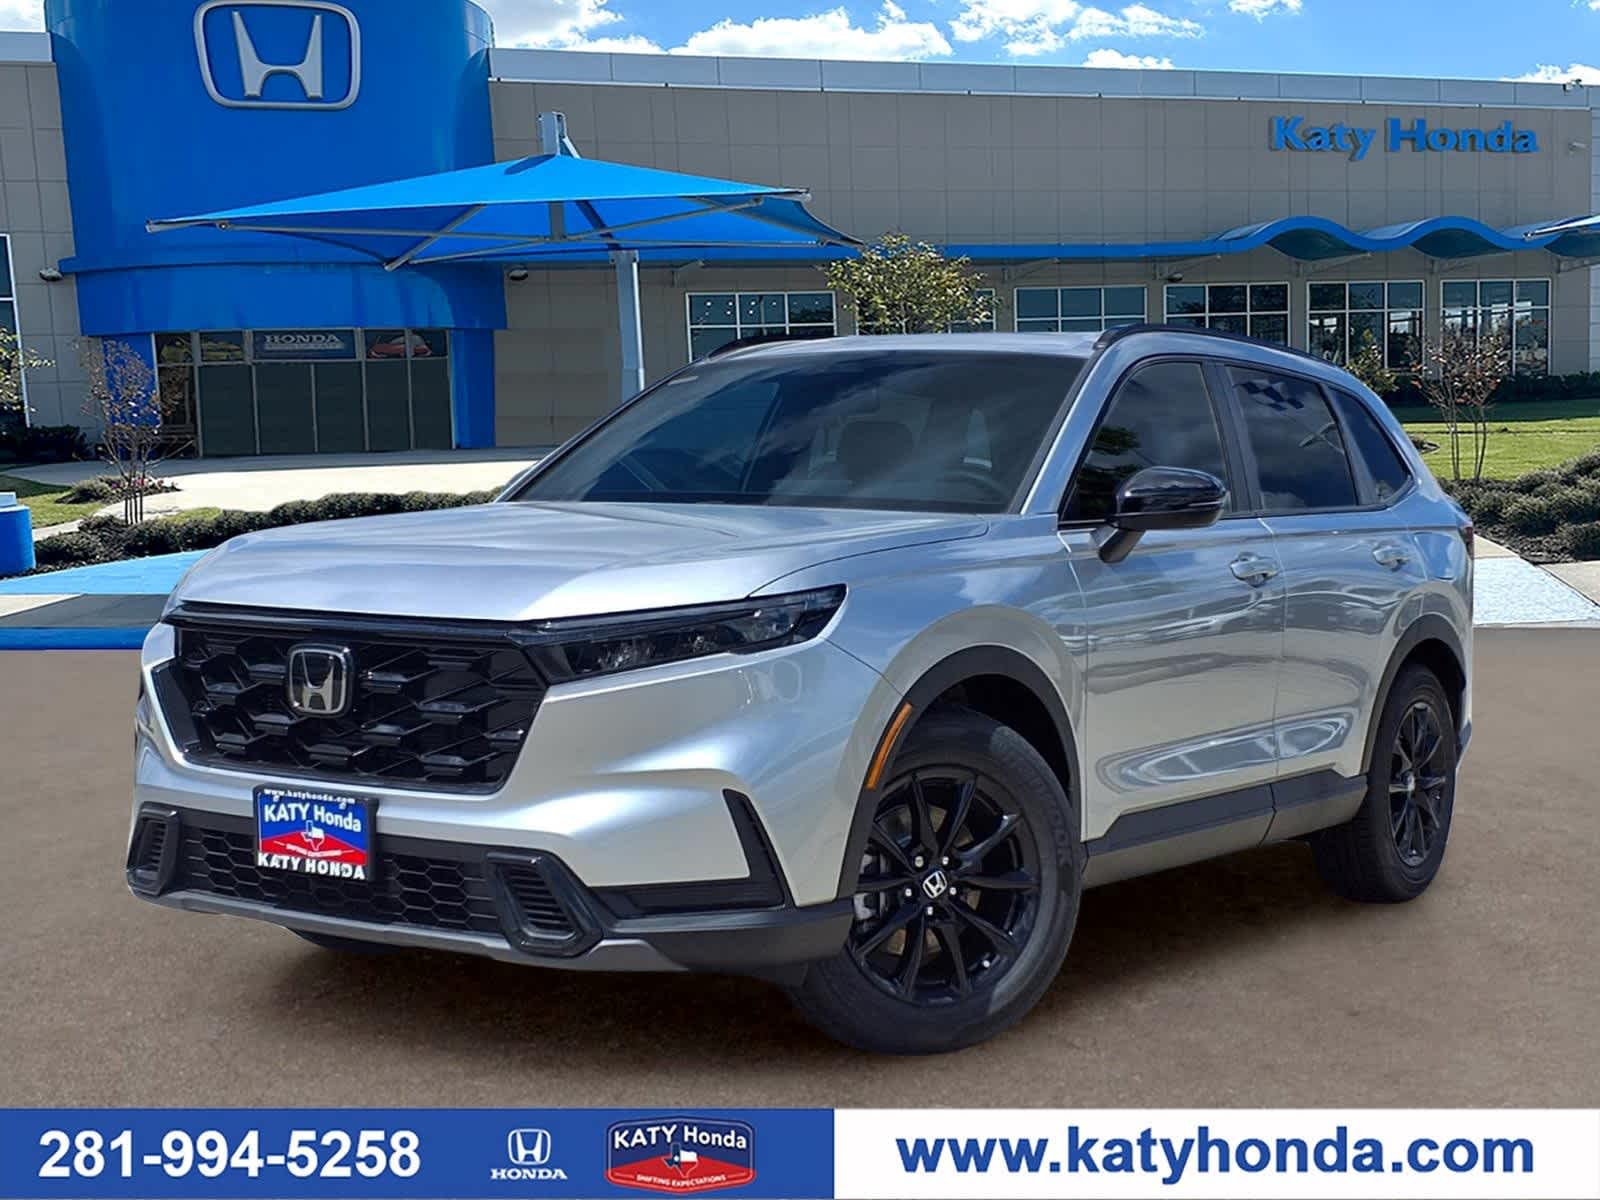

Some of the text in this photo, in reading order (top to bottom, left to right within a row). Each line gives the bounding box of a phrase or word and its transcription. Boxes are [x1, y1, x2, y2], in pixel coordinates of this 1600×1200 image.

[1270, 116, 1539, 161] Katy Honda
[264, 334, 343, 345] HONDA
[264, 803, 362, 833] KATY Honda
[258, 852, 366, 880] KATY HONDA
